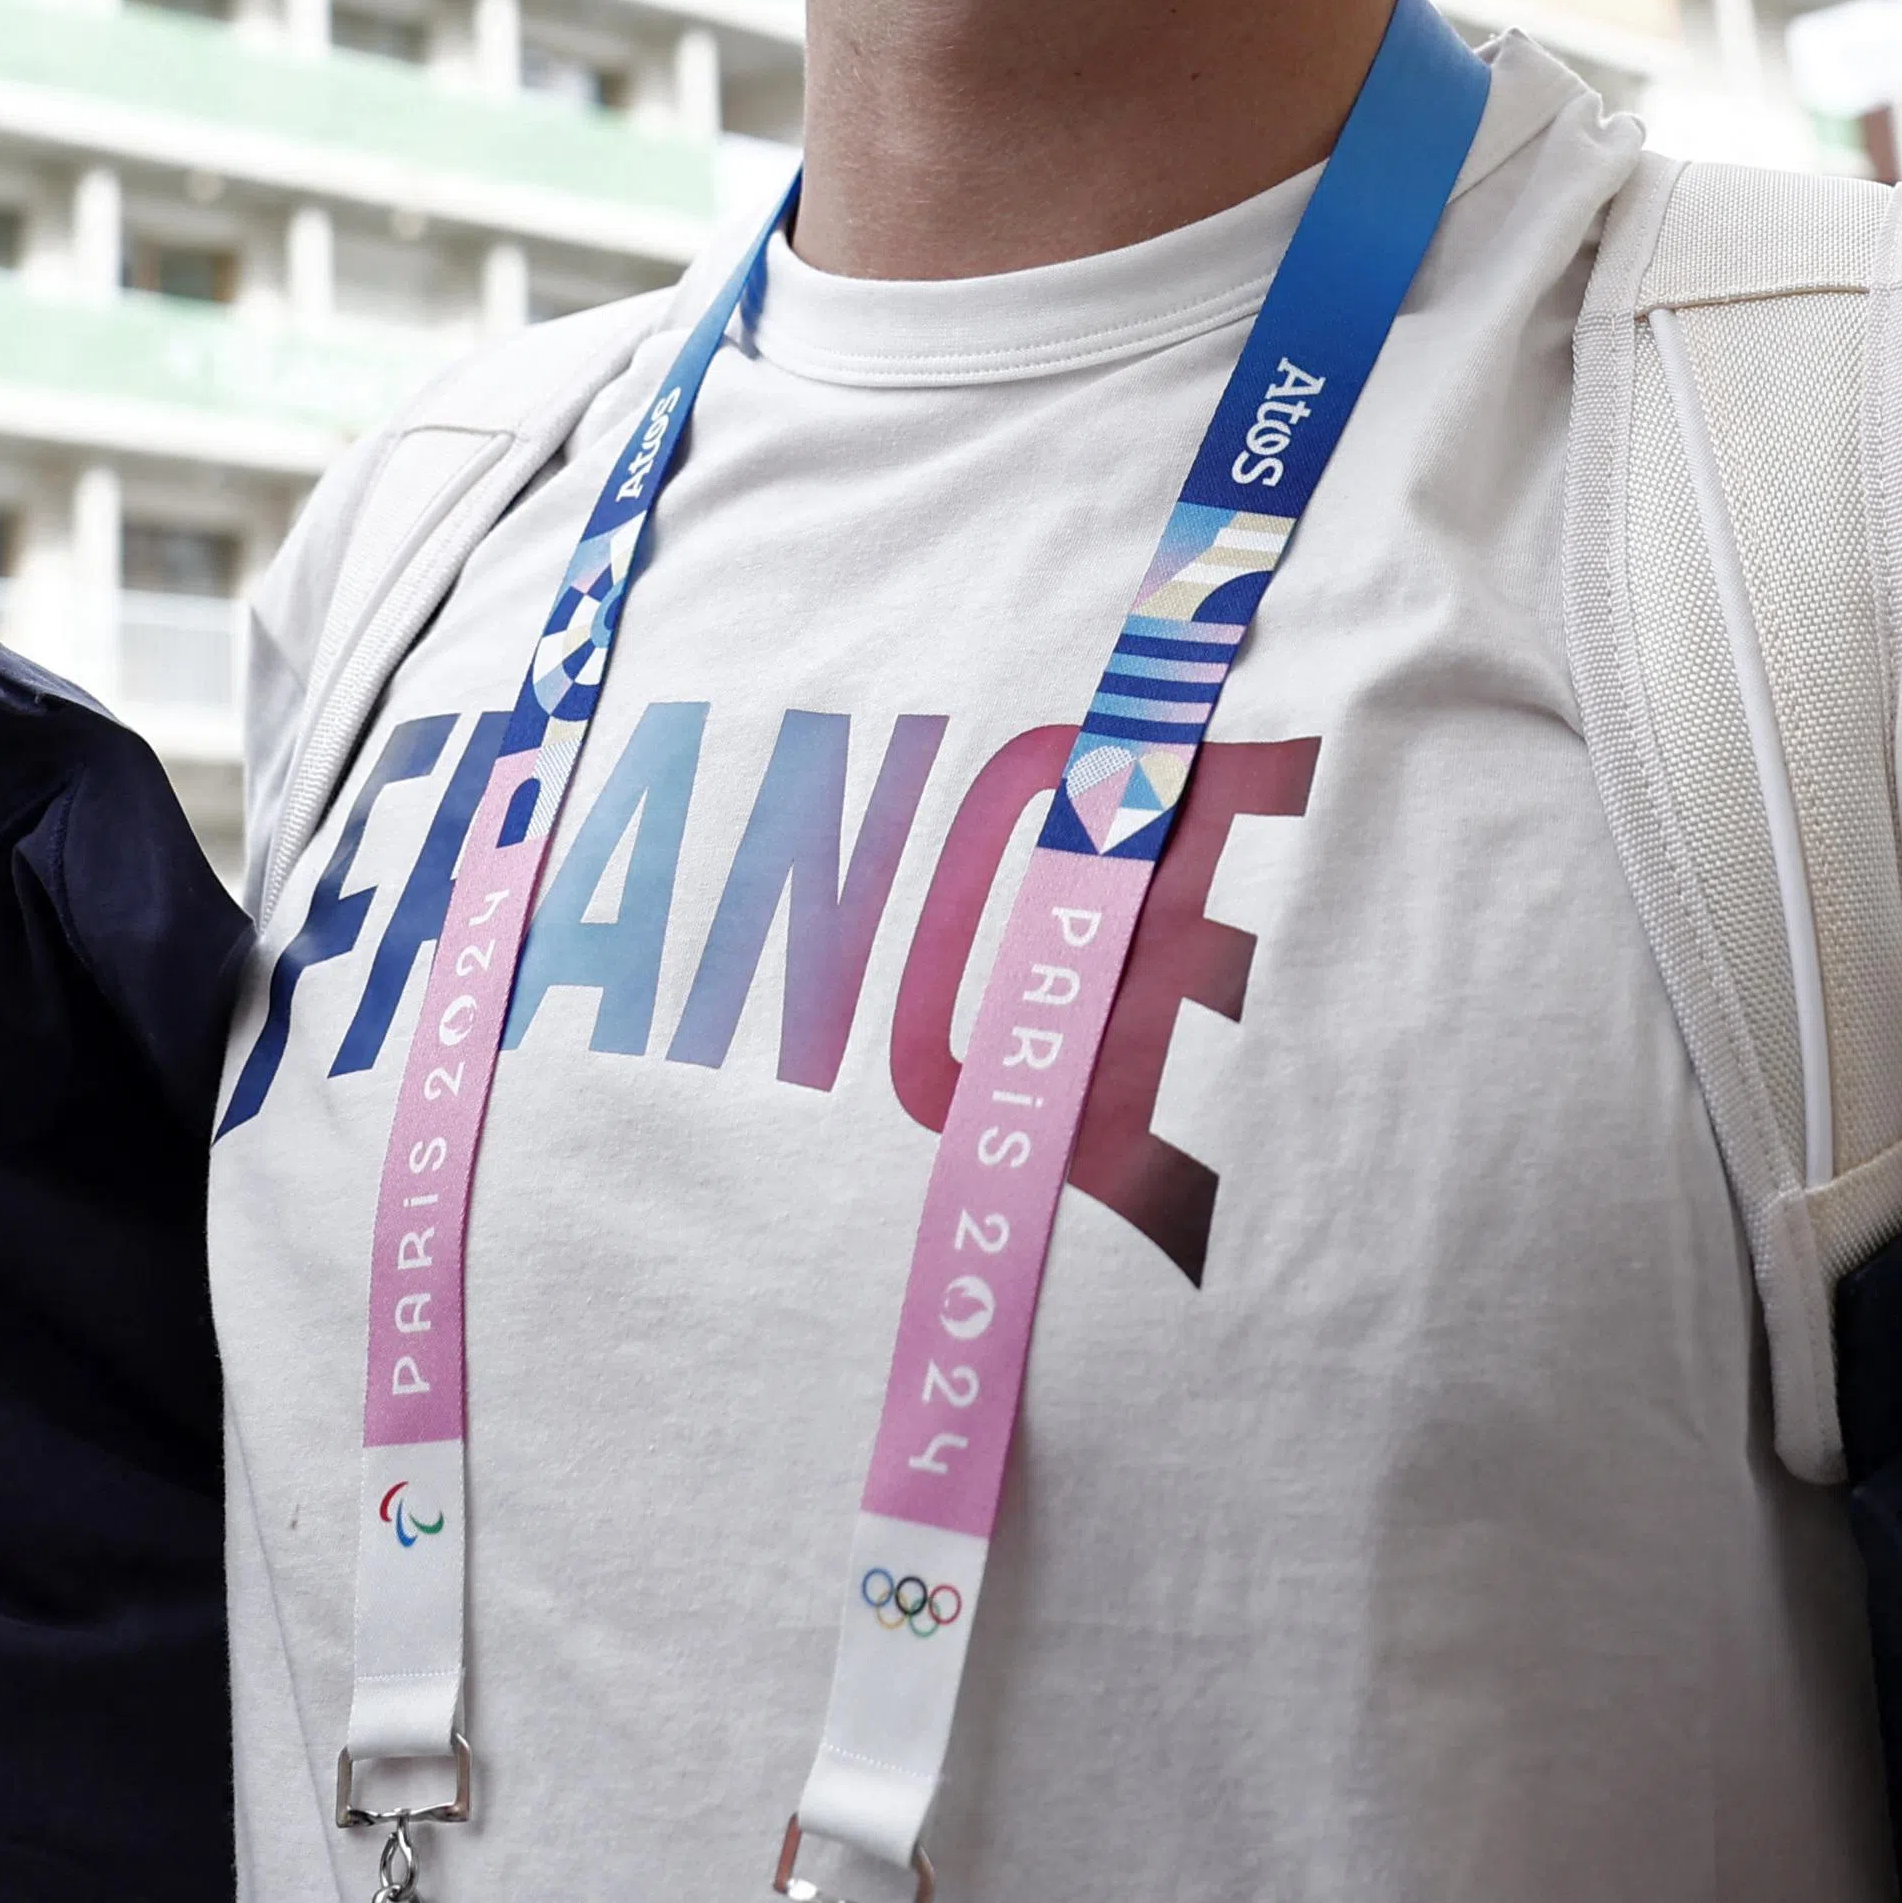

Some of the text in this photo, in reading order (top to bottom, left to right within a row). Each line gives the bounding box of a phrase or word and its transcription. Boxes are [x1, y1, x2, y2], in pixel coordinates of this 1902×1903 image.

[615, 385, 682, 503] Atos
[1230, 356, 1327, 488] Atos
[423, 888, 510, 1101] 2024
[907, 1207, 1011, 1476] 2024
